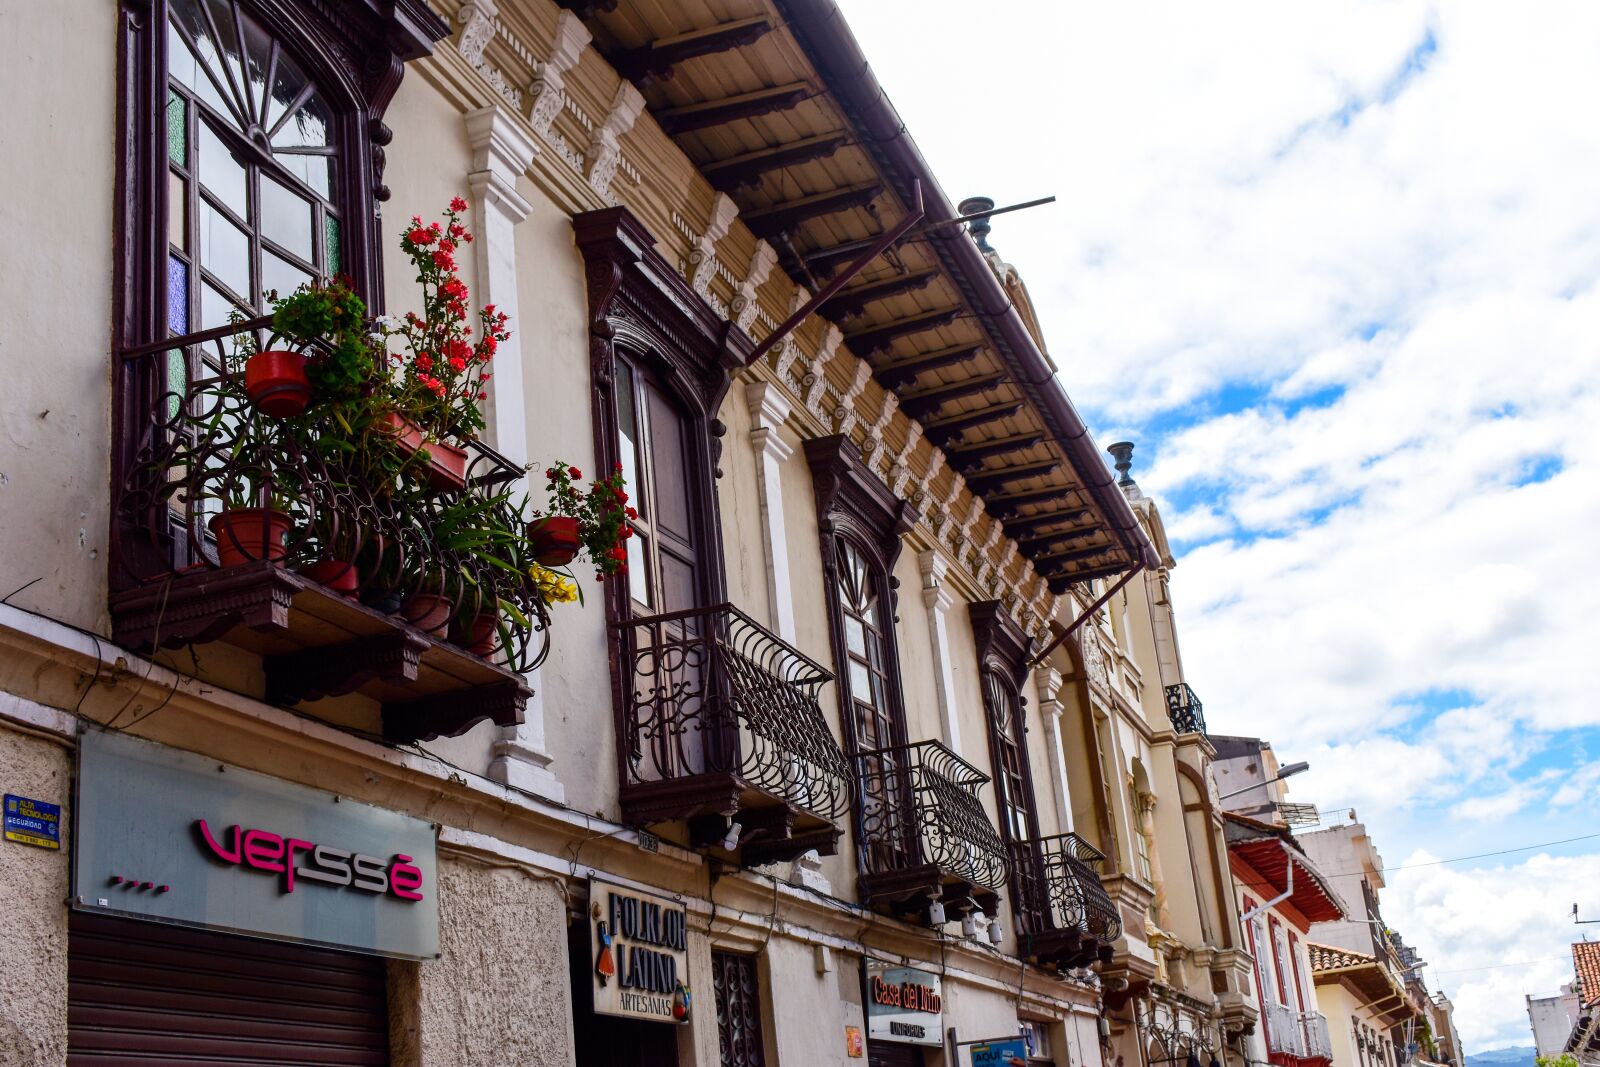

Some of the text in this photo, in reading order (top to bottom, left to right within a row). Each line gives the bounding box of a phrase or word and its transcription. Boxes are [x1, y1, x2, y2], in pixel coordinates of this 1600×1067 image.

[7, 816, 42, 829] SEGURIDAD
[609, 892, 687, 950] FOLKLOR
[617, 943, 678, 994] LATINO
[874, 975, 901, 1007] Casa
[903, 983, 919, 1009] del
